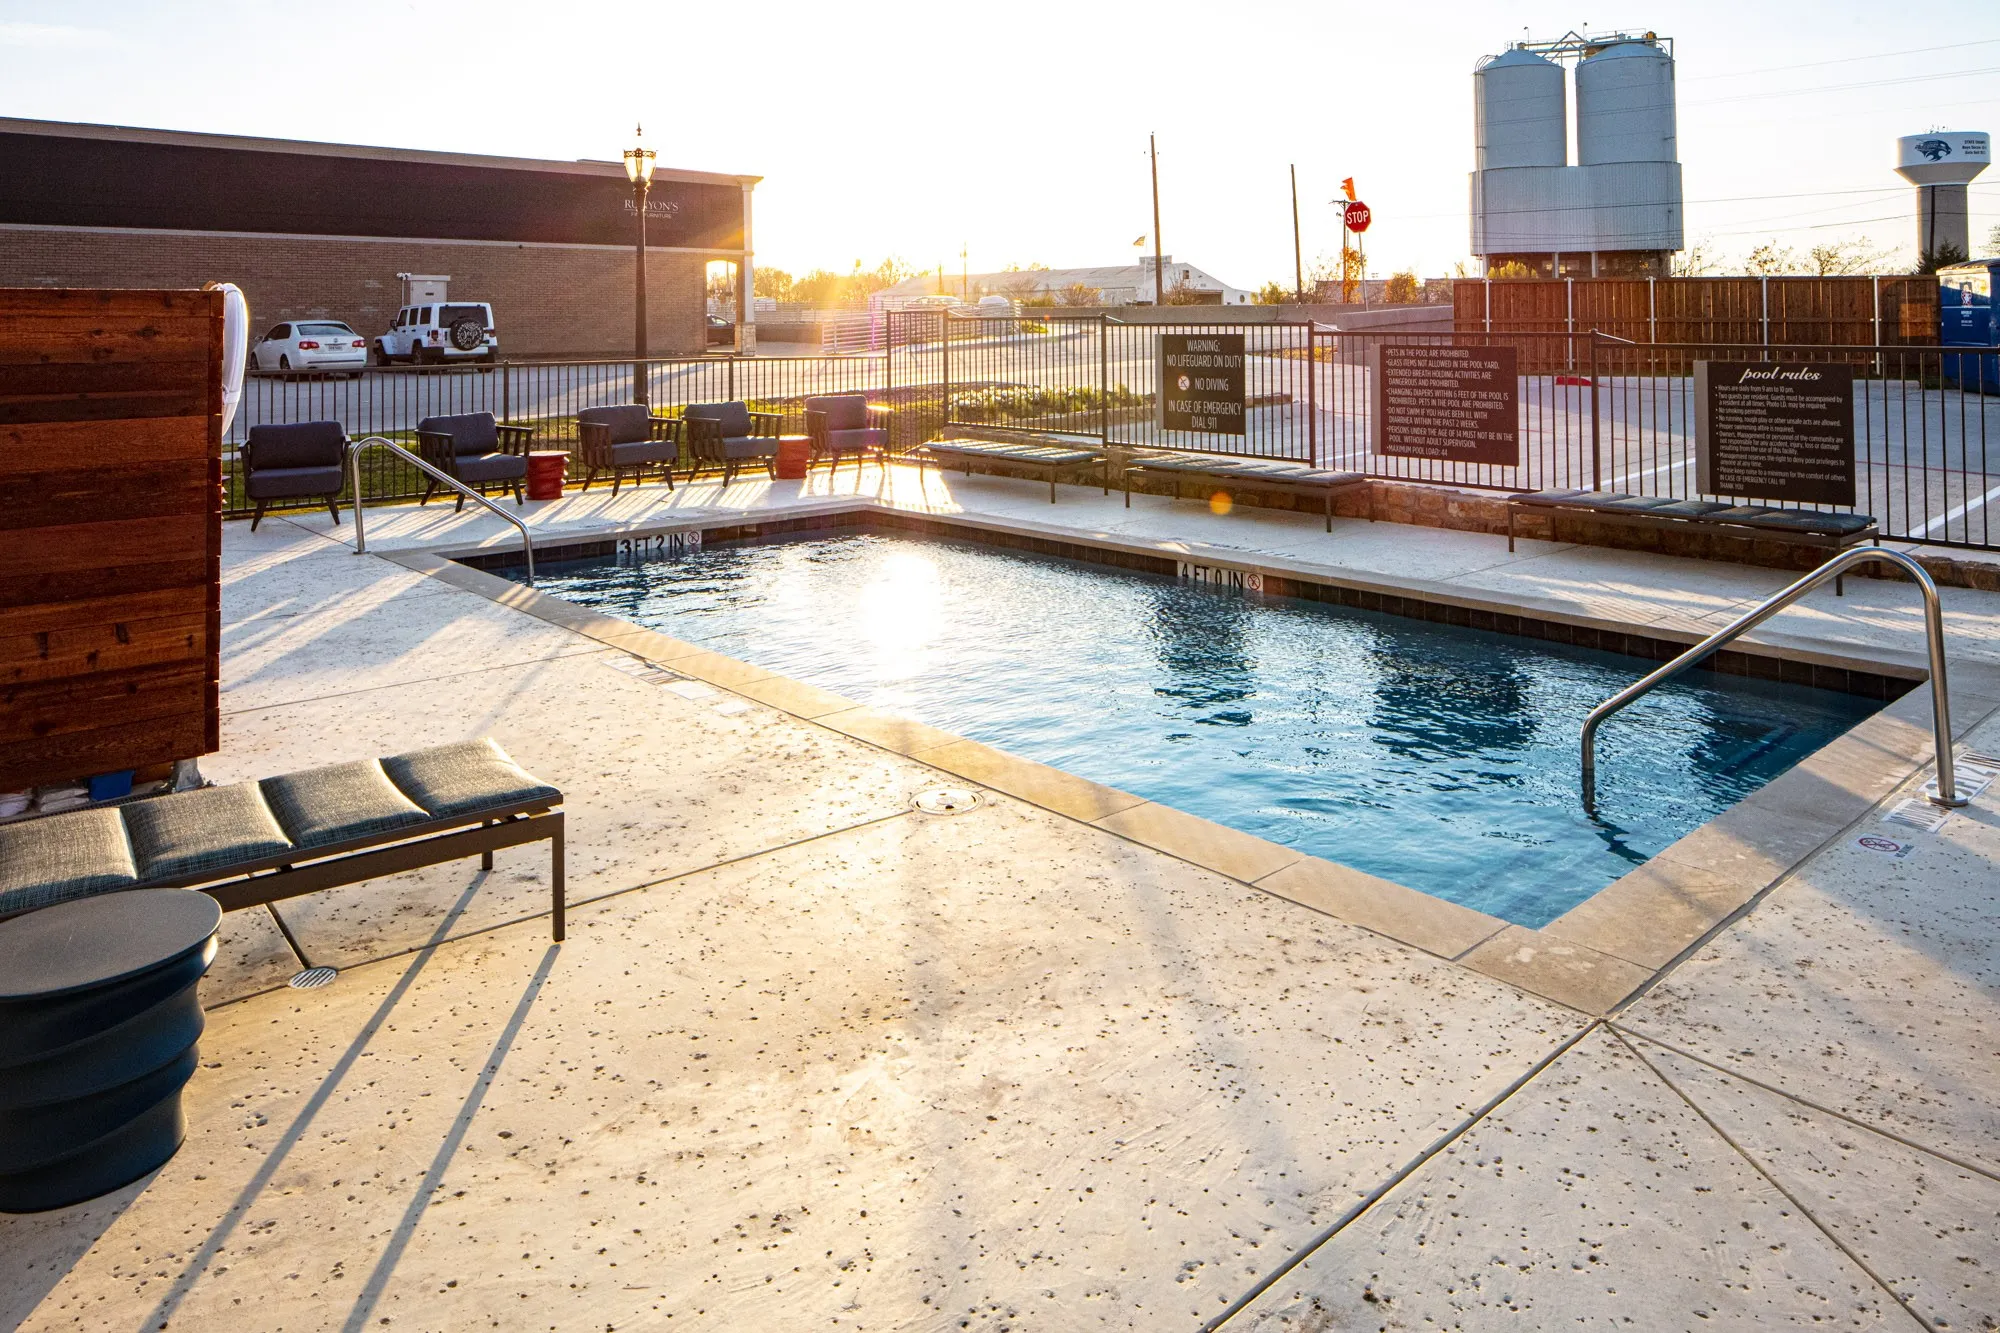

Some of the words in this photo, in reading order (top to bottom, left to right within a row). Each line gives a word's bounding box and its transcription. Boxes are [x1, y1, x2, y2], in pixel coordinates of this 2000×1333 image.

[624, 199, 679, 211] RUYON'S
[1346, 210, 1369, 224] STOP
[1187, 339, 1220, 351] WARNING:
[1406, 349, 1415, 357] THE
[1416, 349, 1428, 357] POOL
[1167, 354, 1177, 366] NO
[1178, 354, 1212, 367] LIFEGUARD
[1213, 355, 1224, 368] ON
[1225, 355, 1242, 368] DUTY
[1388, 359, 1402, 367] GLASS
[1403, 359, 1417, 367] ITEMS
[1418, 359, 1427, 367] NOT
[1429, 360, 1451, 368] ALLOWED
[1460, 360, 1469, 368] THE
[1470, 361, 1483, 369] POOL
[1484, 361, 1499, 369] YARD.
[1388, 369, 1411, 377] EXTENDED
[1412, 369, 1431, 378] BREATH
[1432, 370, 1454, 378] HOLDING
[1455, 371, 1480, 379] ACTIVITIES
[1481, 371, 1492, 380] ARE
[1739, 366, 1780, 383] pool
[1780, 366, 1822, 380] rules
[1195, 378, 1204, 389] NO
[1206, 378, 1229, 391] DIVING
[1389, 378, 1417, 386] DANGEROUS
[1419, 379, 1429, 387] AND
[1388, 388, 1413, 396] CHANGING
[1413, 389, 1433, 397] DIAPERS
[1435, 390, 1452, 398] WITHIN
[1458, 390, 1470, 399] FEET
[1470, 391, 1477, 399] OF
[1479, 391, 1487, 400] THE
[1489, 392, 1502, 400] POOL
[1169, 399, 1175, 411] IN
[1176, 400, 1192, 412] CASE
[1193, 401, 1201, 413] OF
[1203, 401, 1242, 415] EMERGENCY
[1419, 398, 1430, 406] PETS
[1437, 399, 1446, 407] THE
[1447, 399, 1460, 408] POOL
[1462, 400, 1471, 408] ARE
[1396, 407, 1405, 415] NOT
[1407, 408, 1420, 416] SWIM
[1427, 409, 1436, 417] YOU
[1438, 409, 1450, 417] HAVE
[1452, 410, 1464, 418] BEEN
[1474, 411, 1488, 419] WITH
[1191, 415, 1206, 428] DIAL
[1208, 416, 1217, 429] 911
[1414, 417, 1431, 426] WITHIN
[1433, 418, 1441, 426] THE
[1443, 419, 1455, 427] PAST
[1389, 426, 1409, 434] PERSONS
[1411, 427, 1427, 435] UNDER
[1428, 428, 1437, 436] THE
[1438, 429, 1446, 437] AGE
[1449, 429, 1455, 437] OF
[1463, 430, 1476, 439] MUST
[1477, 431, 1487, 439] NOT
[1504, 433, 1513, 441] THE
[1404, 436, 1426, 445] WITHOUT
[1427, 437, 1441, 446] ADULT
[1389, 445, 1411, 453] MAXIMUM
[1412, 446, 1425, 454] POOL
[1441, 448, 1448, 456] 44
[635, 537, 650, 551] FT
[655, 535, 665, 549] 2
[670, 533, 684, 547] IN
[1182, 563, 1189, 578] 4
[1194, 565, 1209, 581] FT
[1228, 570, 1244, 588] IN
